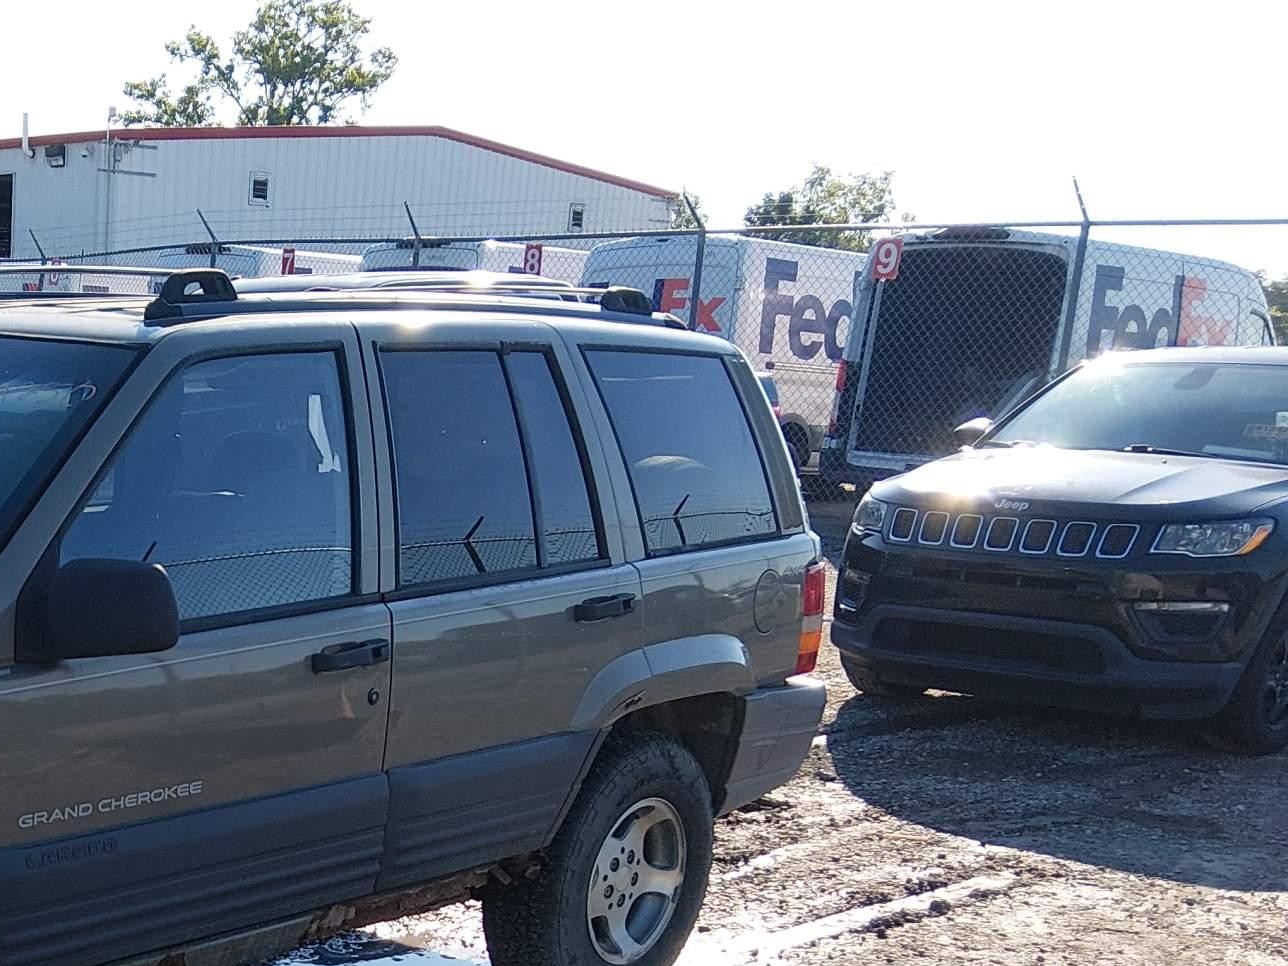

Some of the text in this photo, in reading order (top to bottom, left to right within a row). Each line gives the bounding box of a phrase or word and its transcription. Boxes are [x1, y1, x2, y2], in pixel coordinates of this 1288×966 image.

[285, 254, 294, 272] 7
[525, 249, 540, 274] 8
[878, 242, 898, 275] 9
[994, 498, 1029, 512] Jeep
[18, 780, 203, 829] GRAND CHEROKEE
